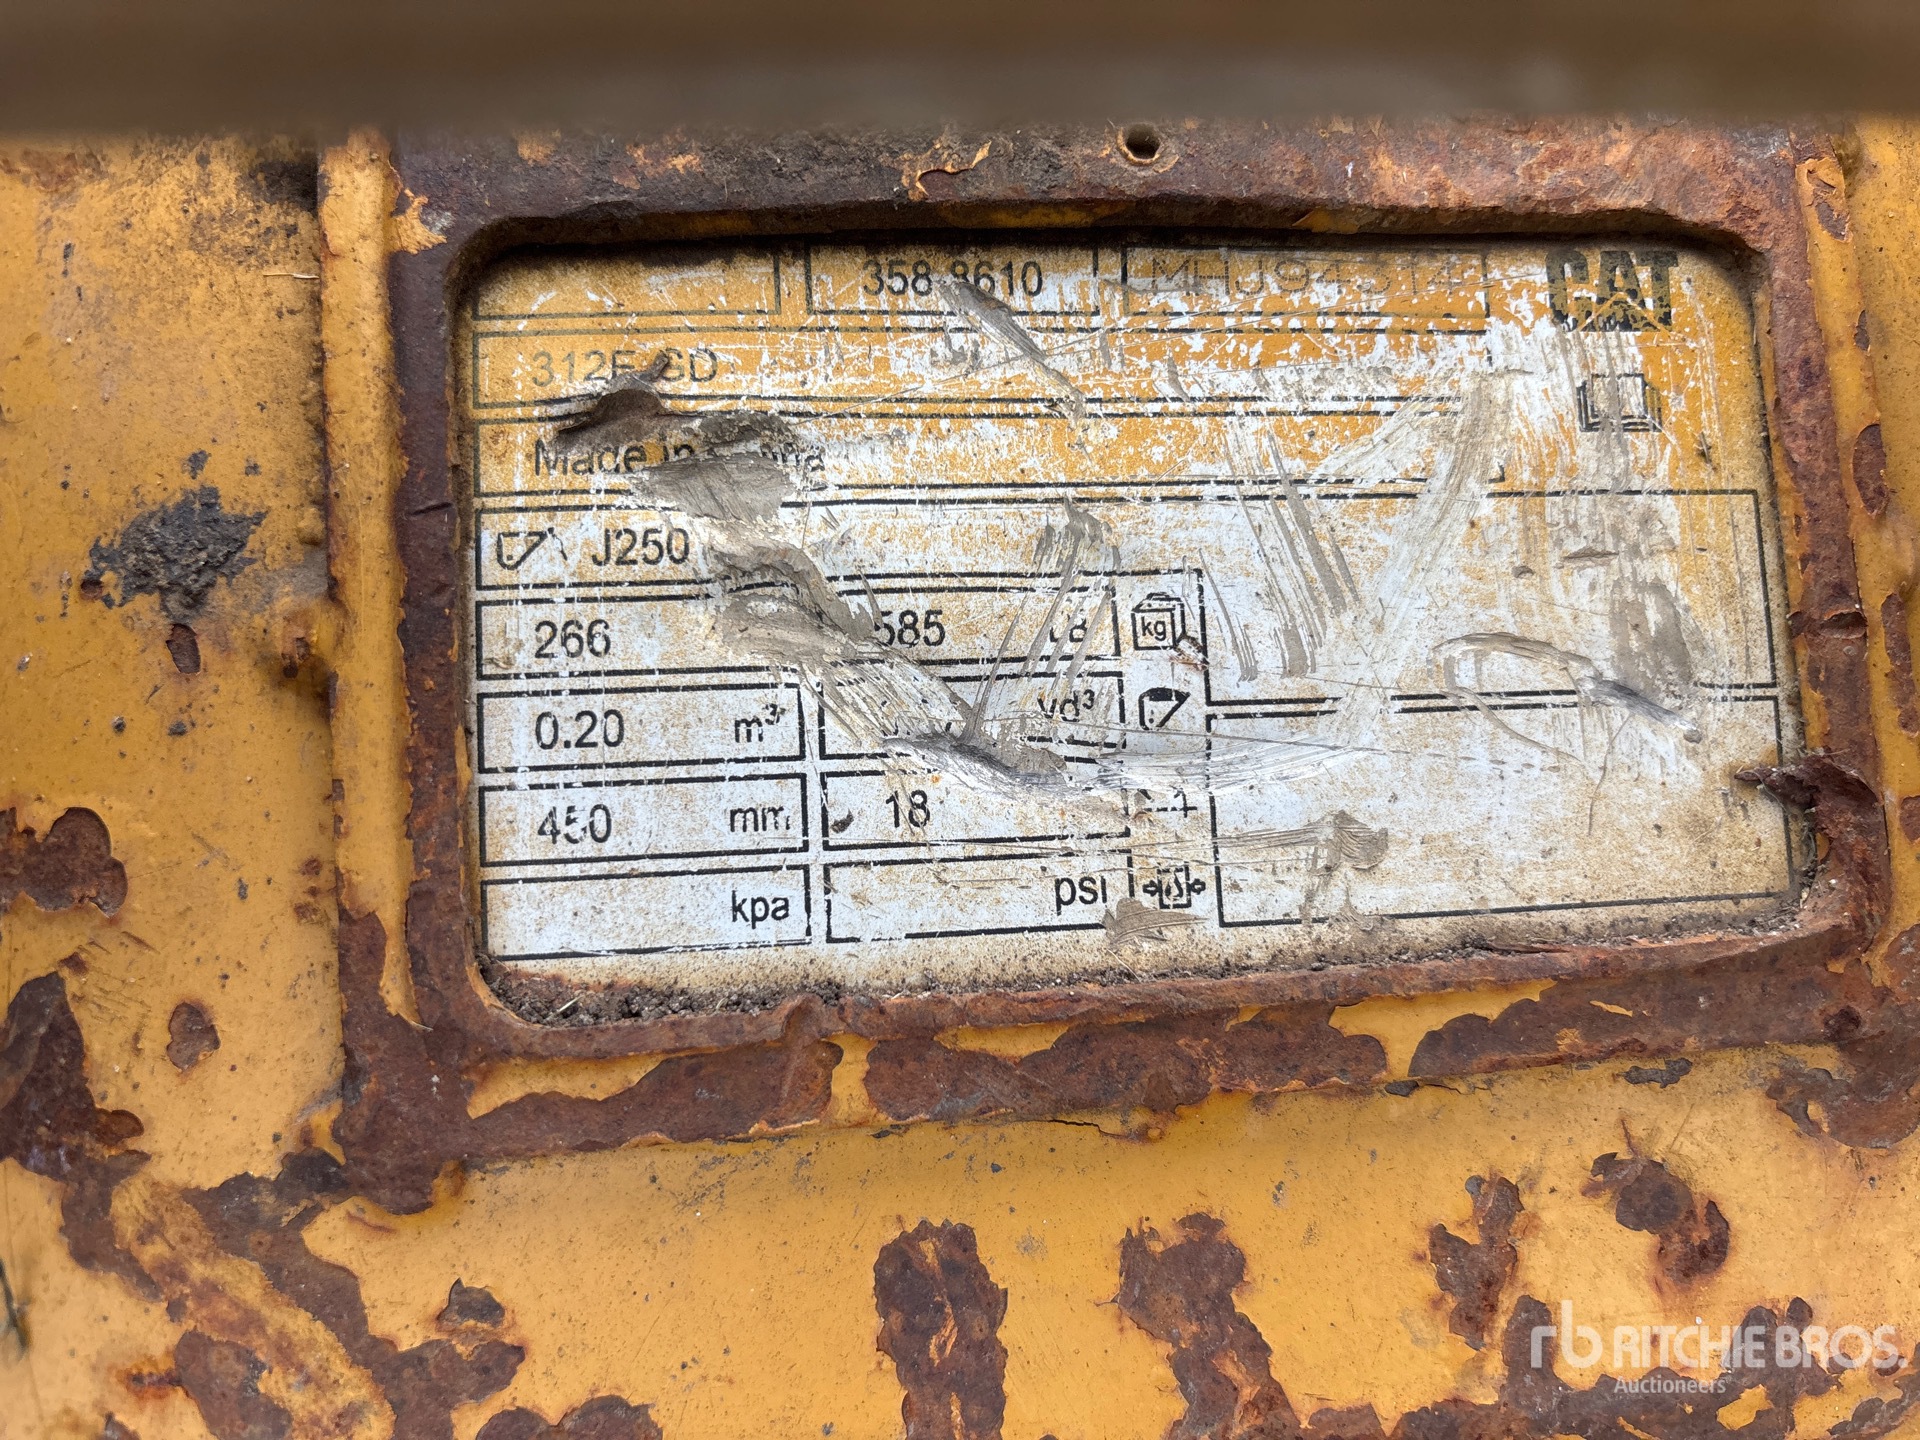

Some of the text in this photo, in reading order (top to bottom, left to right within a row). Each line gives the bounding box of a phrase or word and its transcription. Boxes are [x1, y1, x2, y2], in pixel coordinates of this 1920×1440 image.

[1546, 249, 1679, 332] CAT
[535, 438, 647, 476] Made
[591, 528, 690, 566] J250
[535, 619, 611, 659] 266
[1140, 615, 1166, 641] kg
[536, 708, 625, 750] 0.20
[537, 803, 612, 845] 450
[730, 804, 791, 834] mm
[885, 789, 931, 829] 18
[731, 890, 791, 931] kpa
